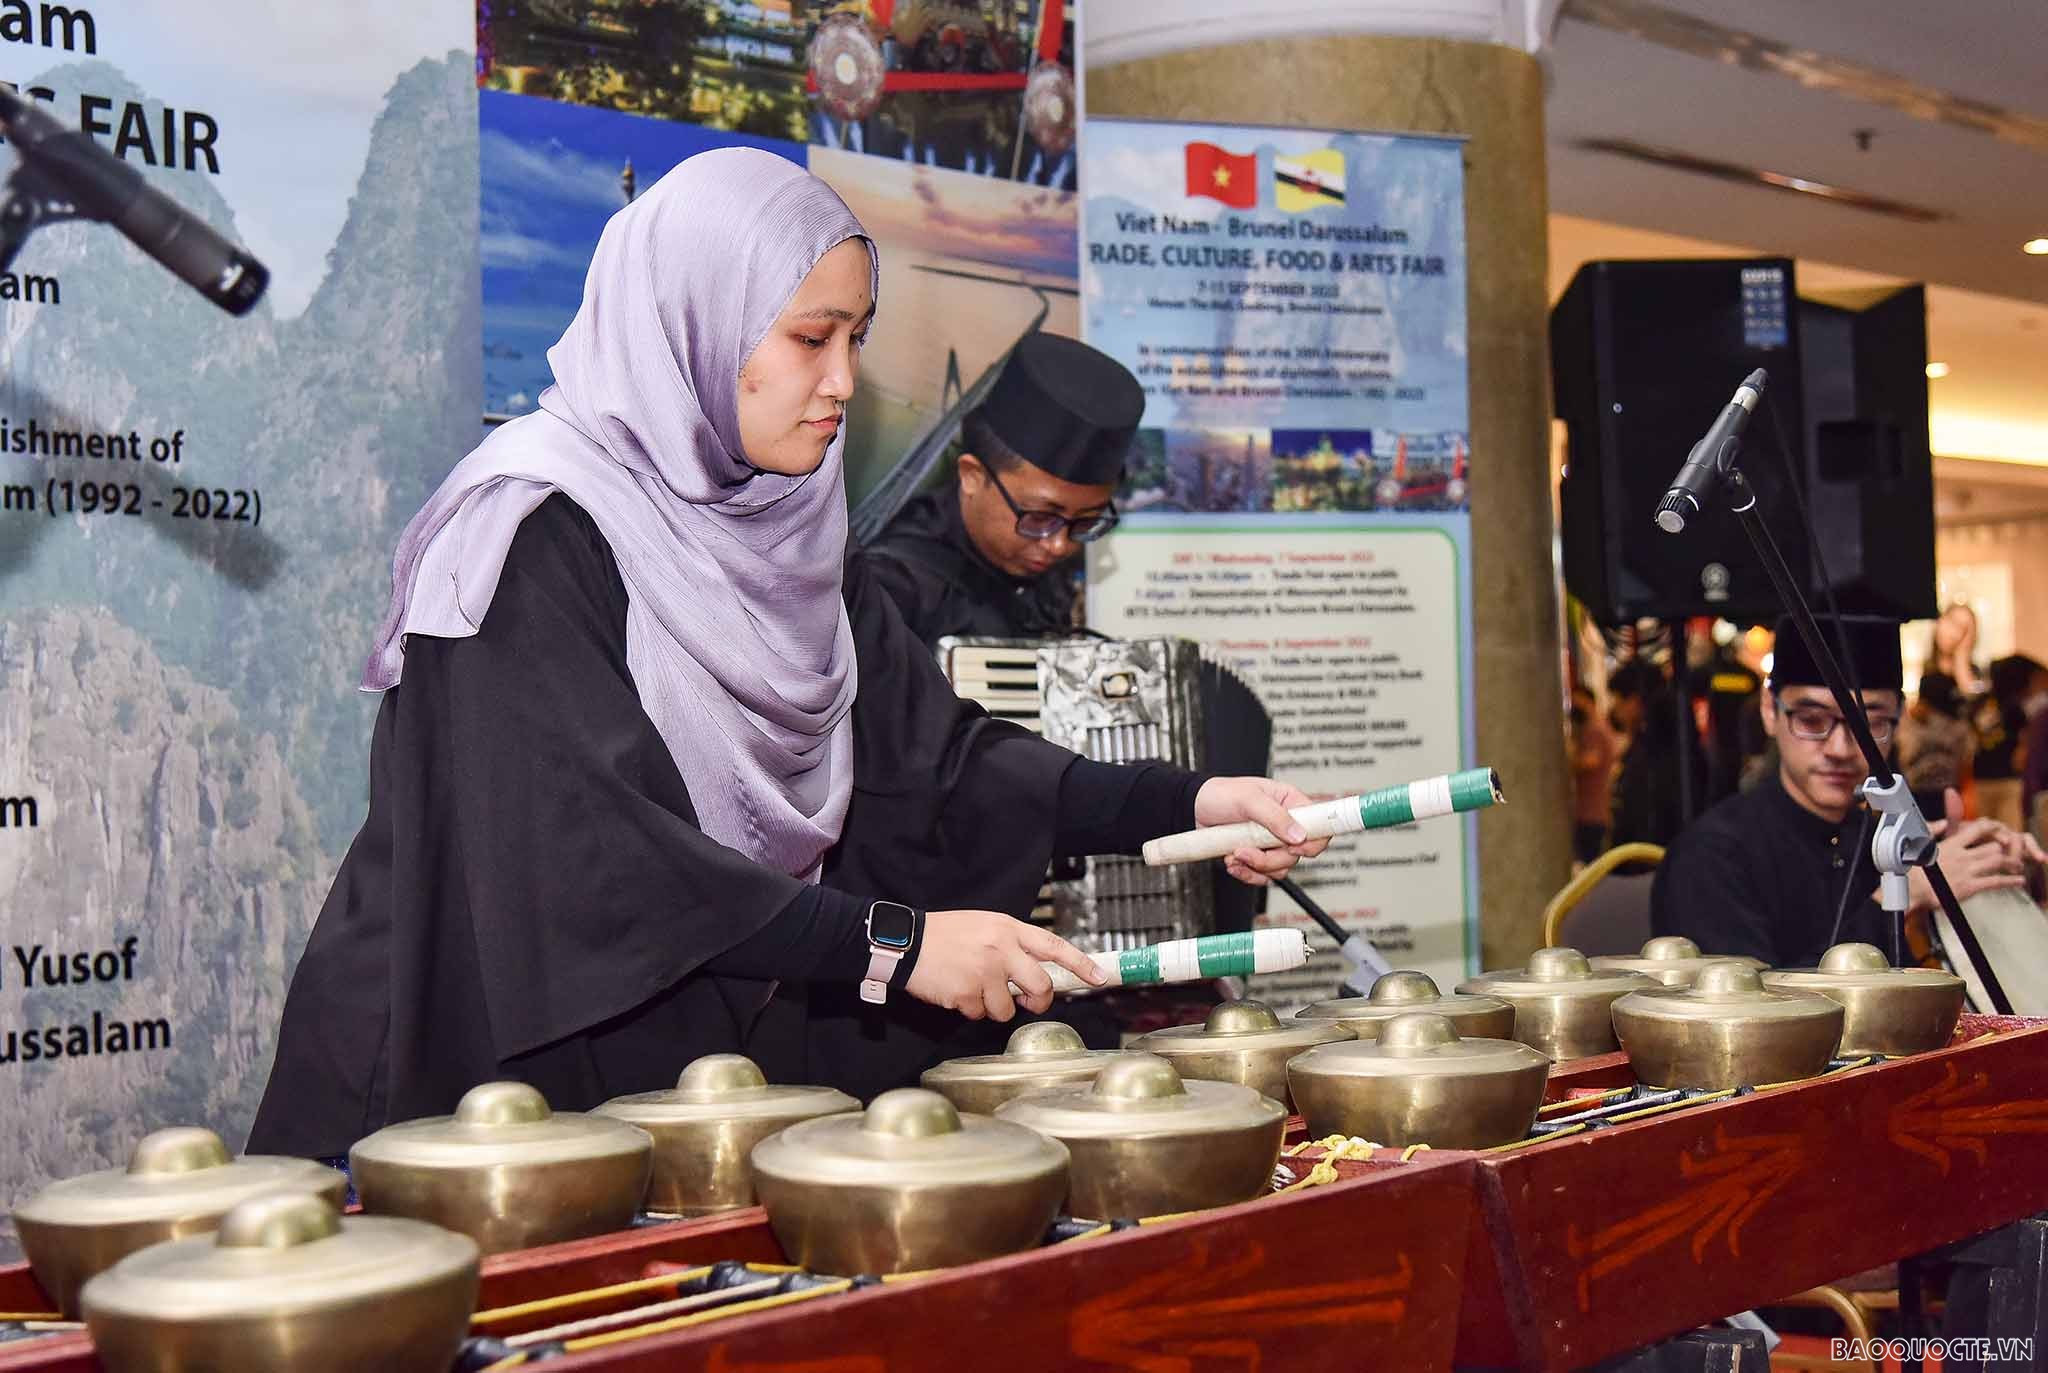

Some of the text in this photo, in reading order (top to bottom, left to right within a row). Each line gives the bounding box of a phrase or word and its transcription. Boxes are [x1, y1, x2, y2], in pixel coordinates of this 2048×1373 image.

[0, 0, 96, 55] am
[80, 94, 220, 175] FAIR
[1115, 212, 1156, 233] Viet
[1162, 215, 1210, 235] Nam
[1228, 216, 1295, 239] Brunei
[1300, 220, 1409, 245] Darussalam
[1161, 245, 1259, 270] CULTURE,
[1265, 249, 1326, 271] FOOD
[1329, 252, 1344, 273] &
[1349, 253, 1397, 275] ARTS
[1401, 255, 1446, 277] FAIR
[0, 272, 60, 304] am
[0, 418, 184, 462] ishment of
[47, 478, 142, 518] (1992
[171, 487, 261, 526] 2022)
[13, 935, 138, 988] Yusof
[0, 1011, 171, 1065] ussalam
